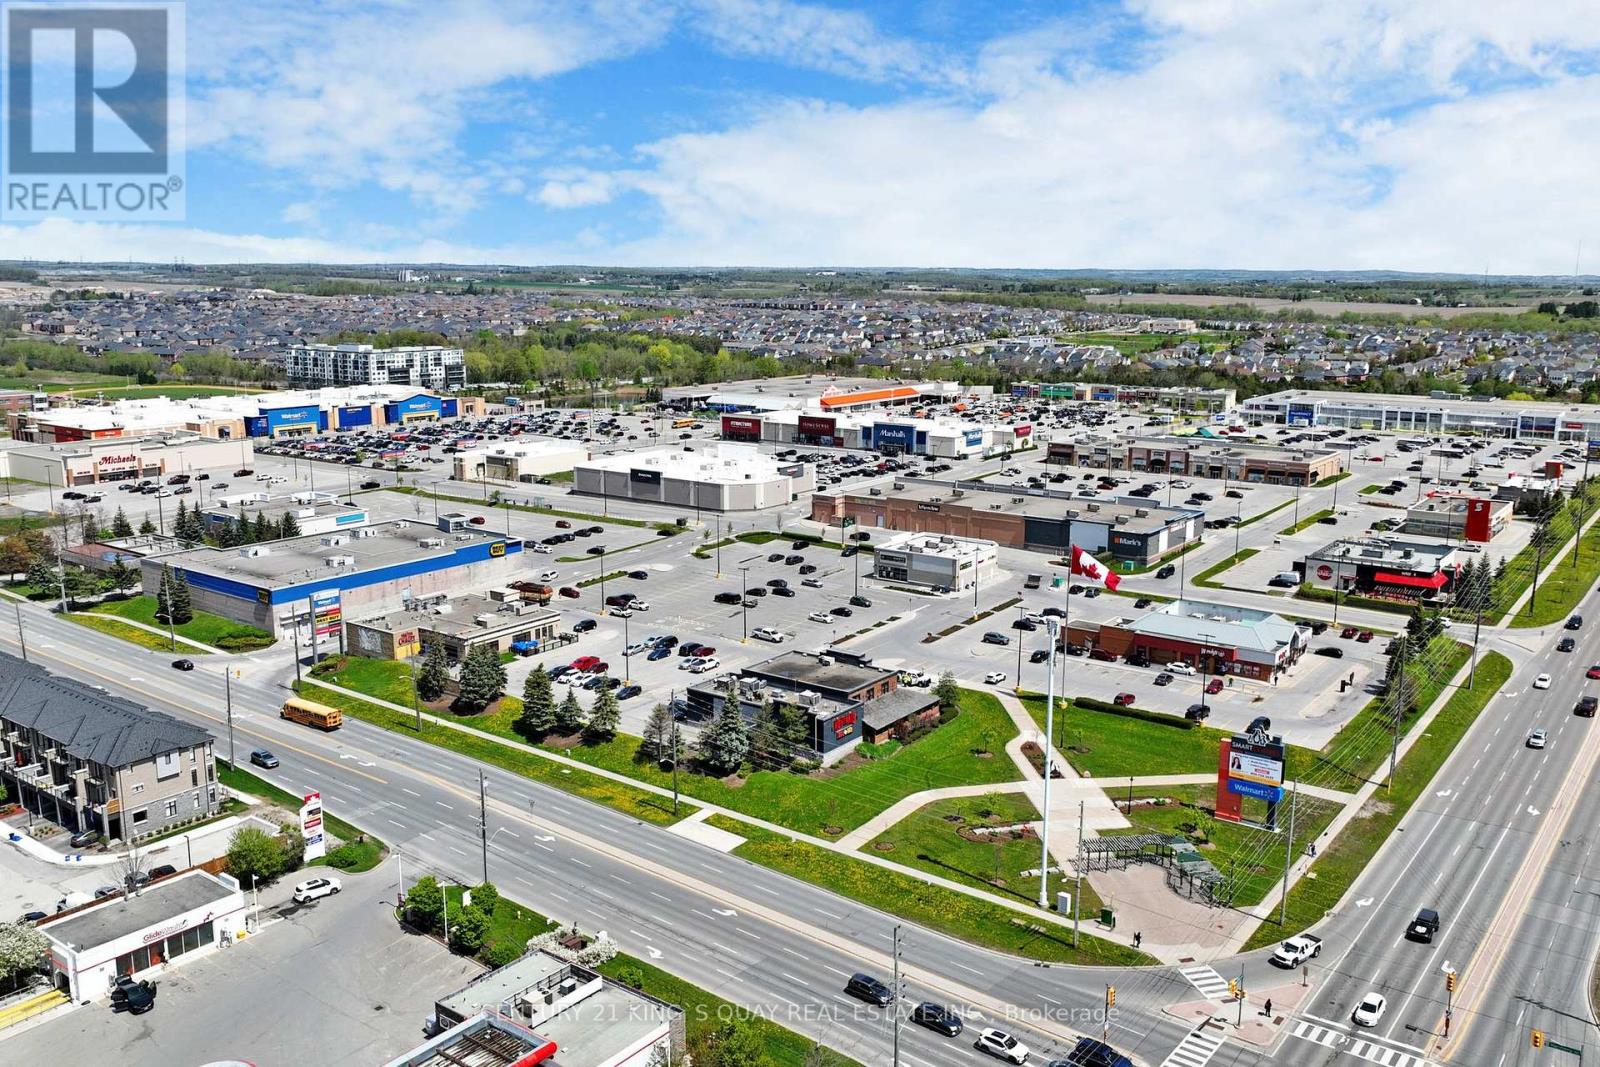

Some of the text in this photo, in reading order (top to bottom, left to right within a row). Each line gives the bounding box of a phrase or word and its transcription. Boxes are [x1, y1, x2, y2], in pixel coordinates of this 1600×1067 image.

[879, 429, 905, 438] Marshalls
[99, 454, 136, 465] Michaels
[1120, 536, 1142, 547] Mark's
[1231, 741, 1254, 751] SMART
[1234, 783, 1264, 798] Walmart
